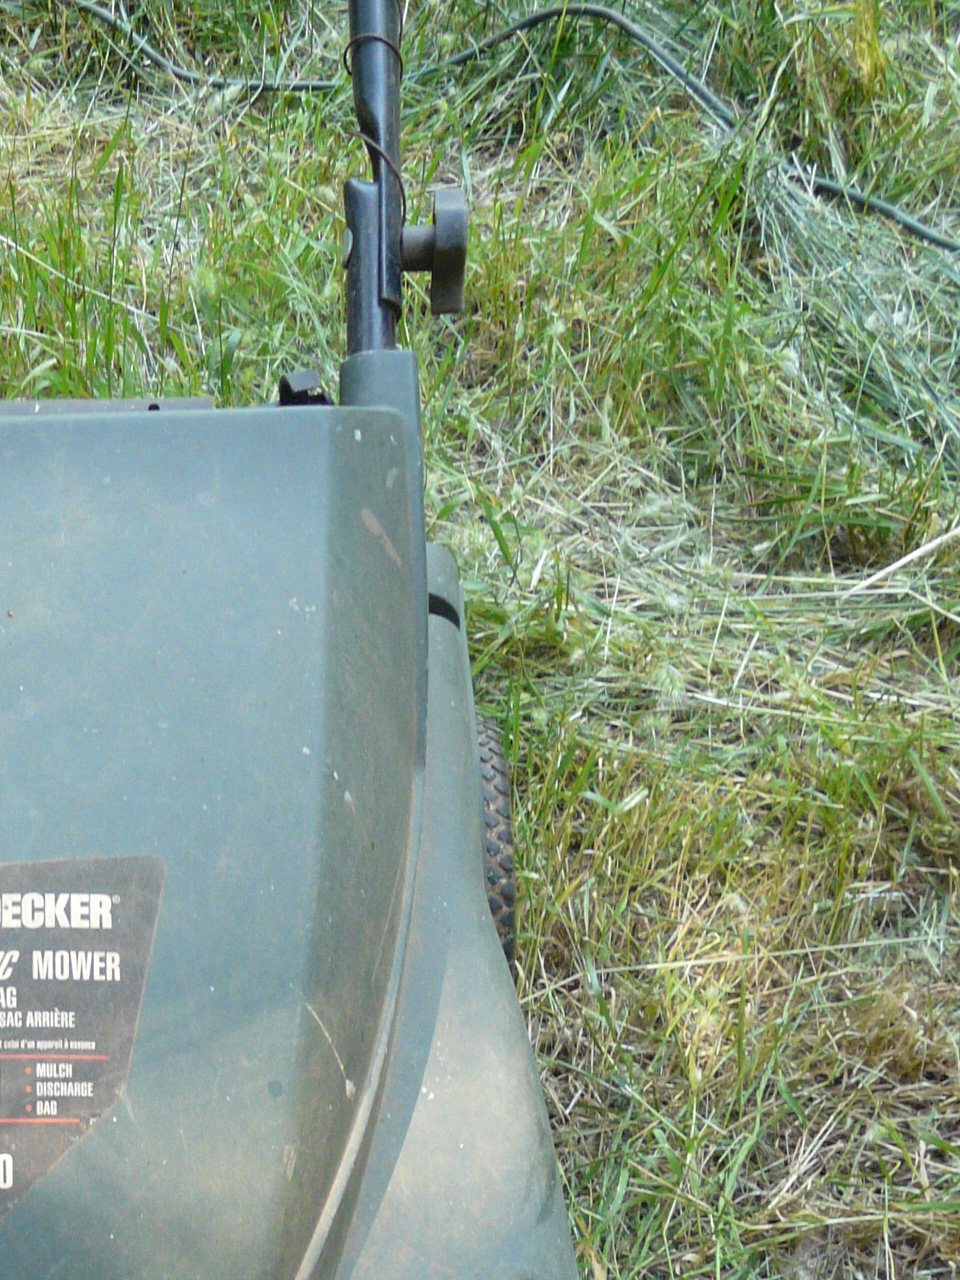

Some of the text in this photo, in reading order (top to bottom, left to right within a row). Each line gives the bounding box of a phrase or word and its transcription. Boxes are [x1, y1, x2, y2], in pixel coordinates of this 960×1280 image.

[32, 949, 121, 981] MOWER
[26, 1007, 76, 1028] ARRIÈRE
[36, 1063, 73, 1078] MULCH
[36, 1082, 94, 1097] DISCHARGE
[36, 1101, 58, 1115] BAG
